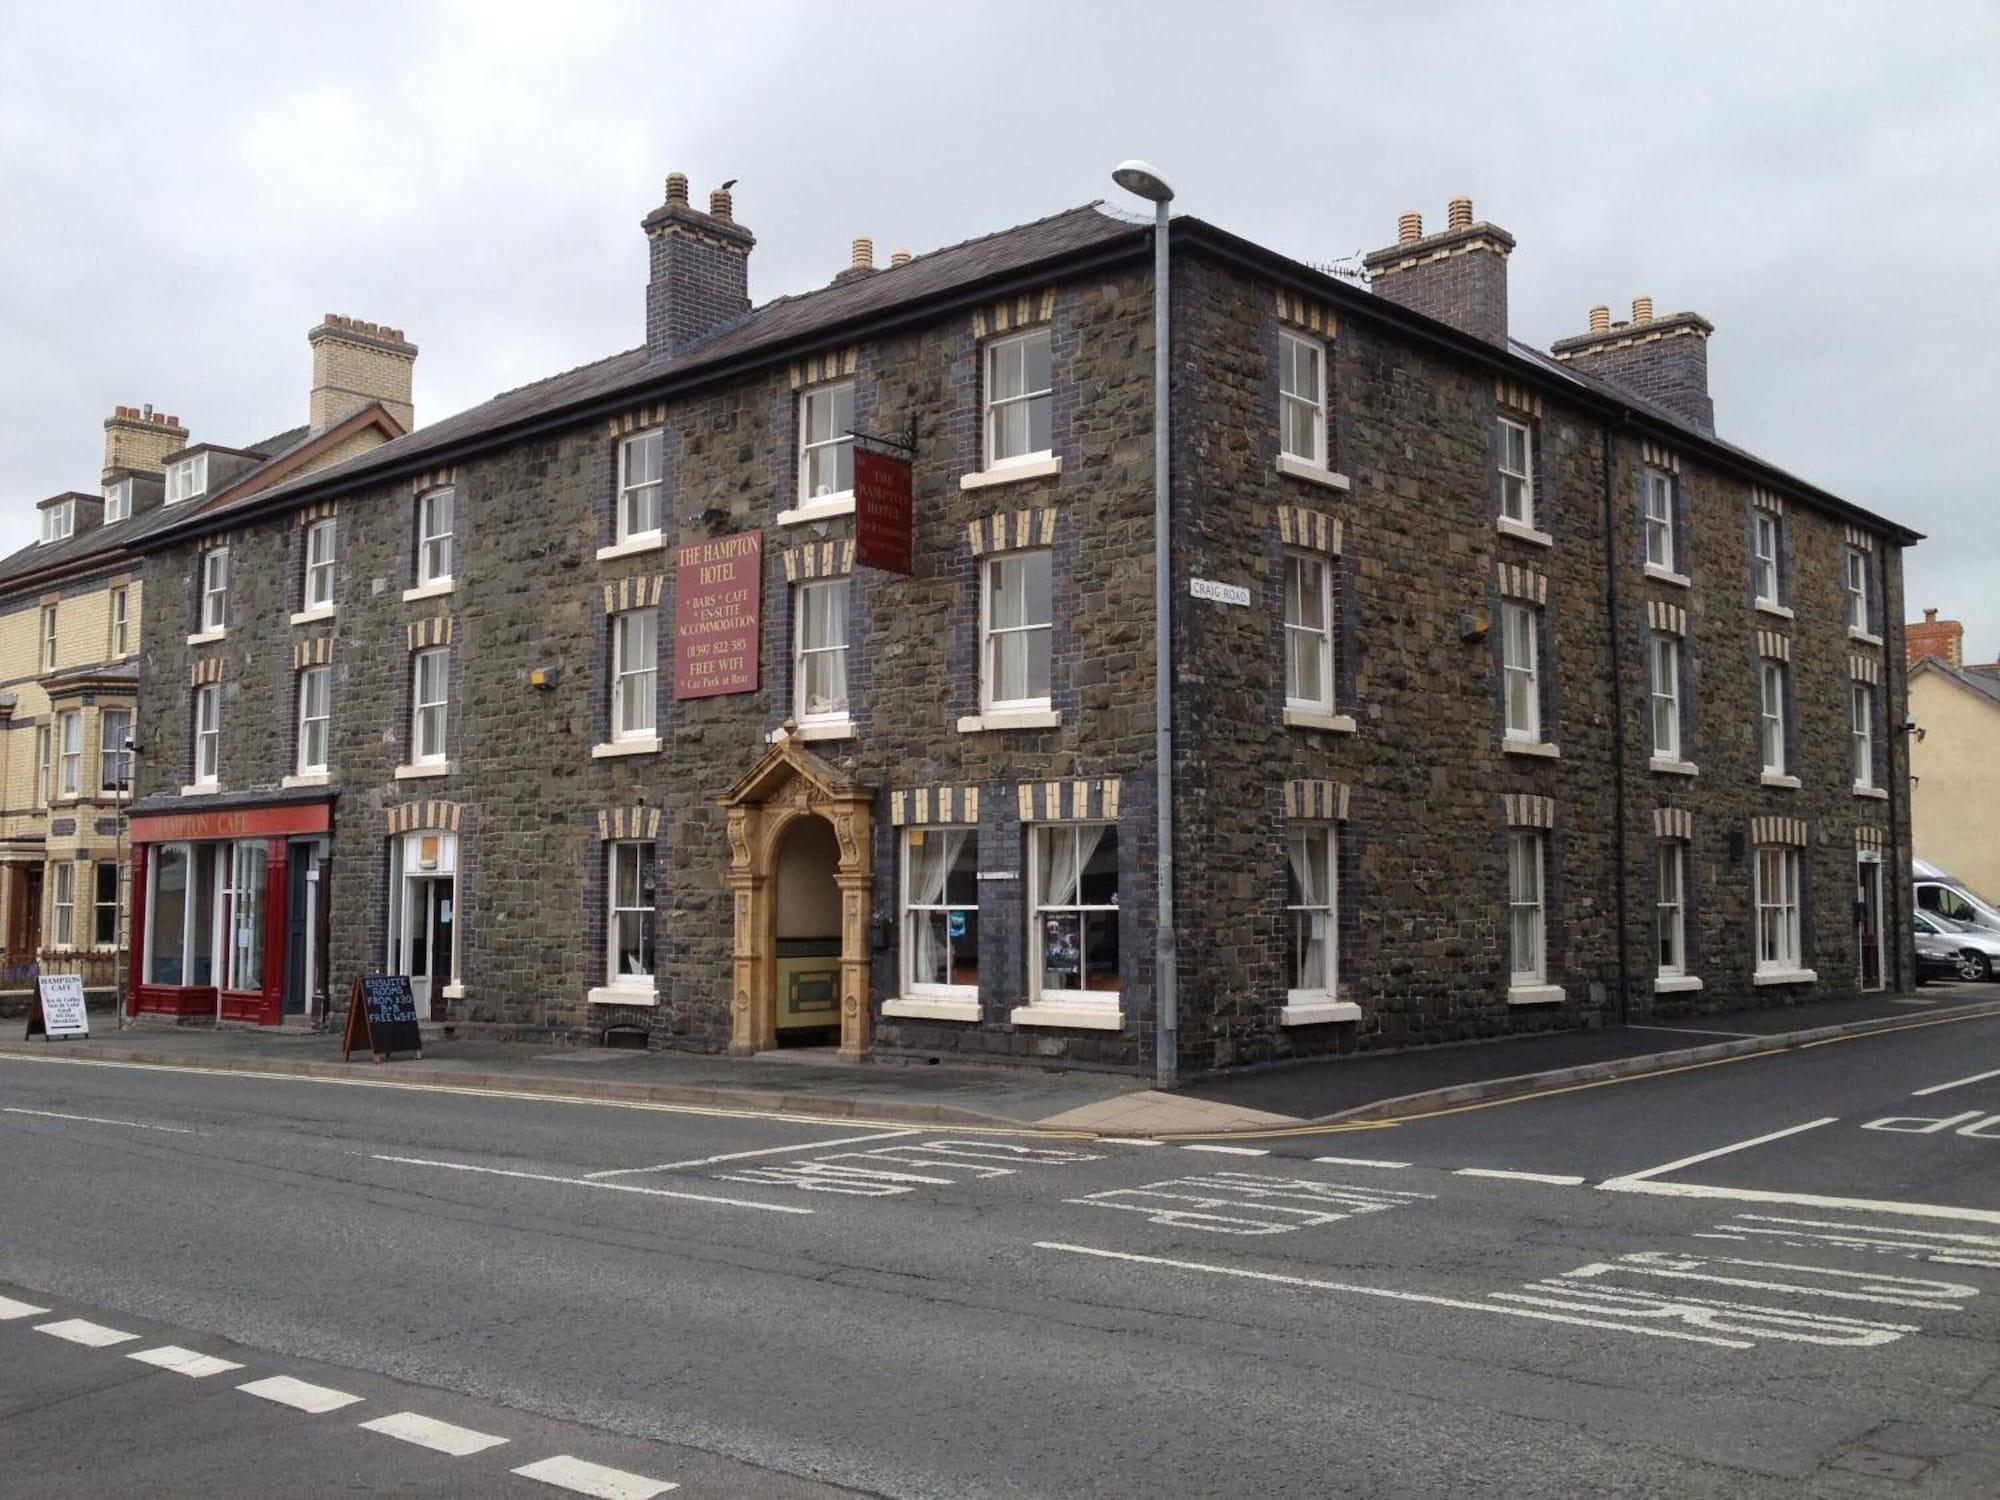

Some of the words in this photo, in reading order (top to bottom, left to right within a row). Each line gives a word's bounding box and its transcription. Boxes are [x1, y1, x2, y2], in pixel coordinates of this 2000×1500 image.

[867, 500, 900, 521] HOTEL
[679, 546, 701, 567] THE
[704, 535, 760, 562] HAMPTON
[700, 562, 736, 585] HOTEL
[692, 594, 716, 609] BARS
[724, 589, 750, 604] CAFE
[1193, 582, 1220, 598] CRAIG
[1223, 587, 1247, 602] ROAD
[678, 614, 755, 637] ACCOMMODATION
[689, 661, 716, 676] FREE
[687, 679, 702, 689] Car
[703, 675, 720, 687] Park
[731, 673, 748, 685] Rear
[153, 814, 209, 834] HAMPTON
[218, 811, 249, 833] CAFE
[373, 986, 404, 996] ROOMS
